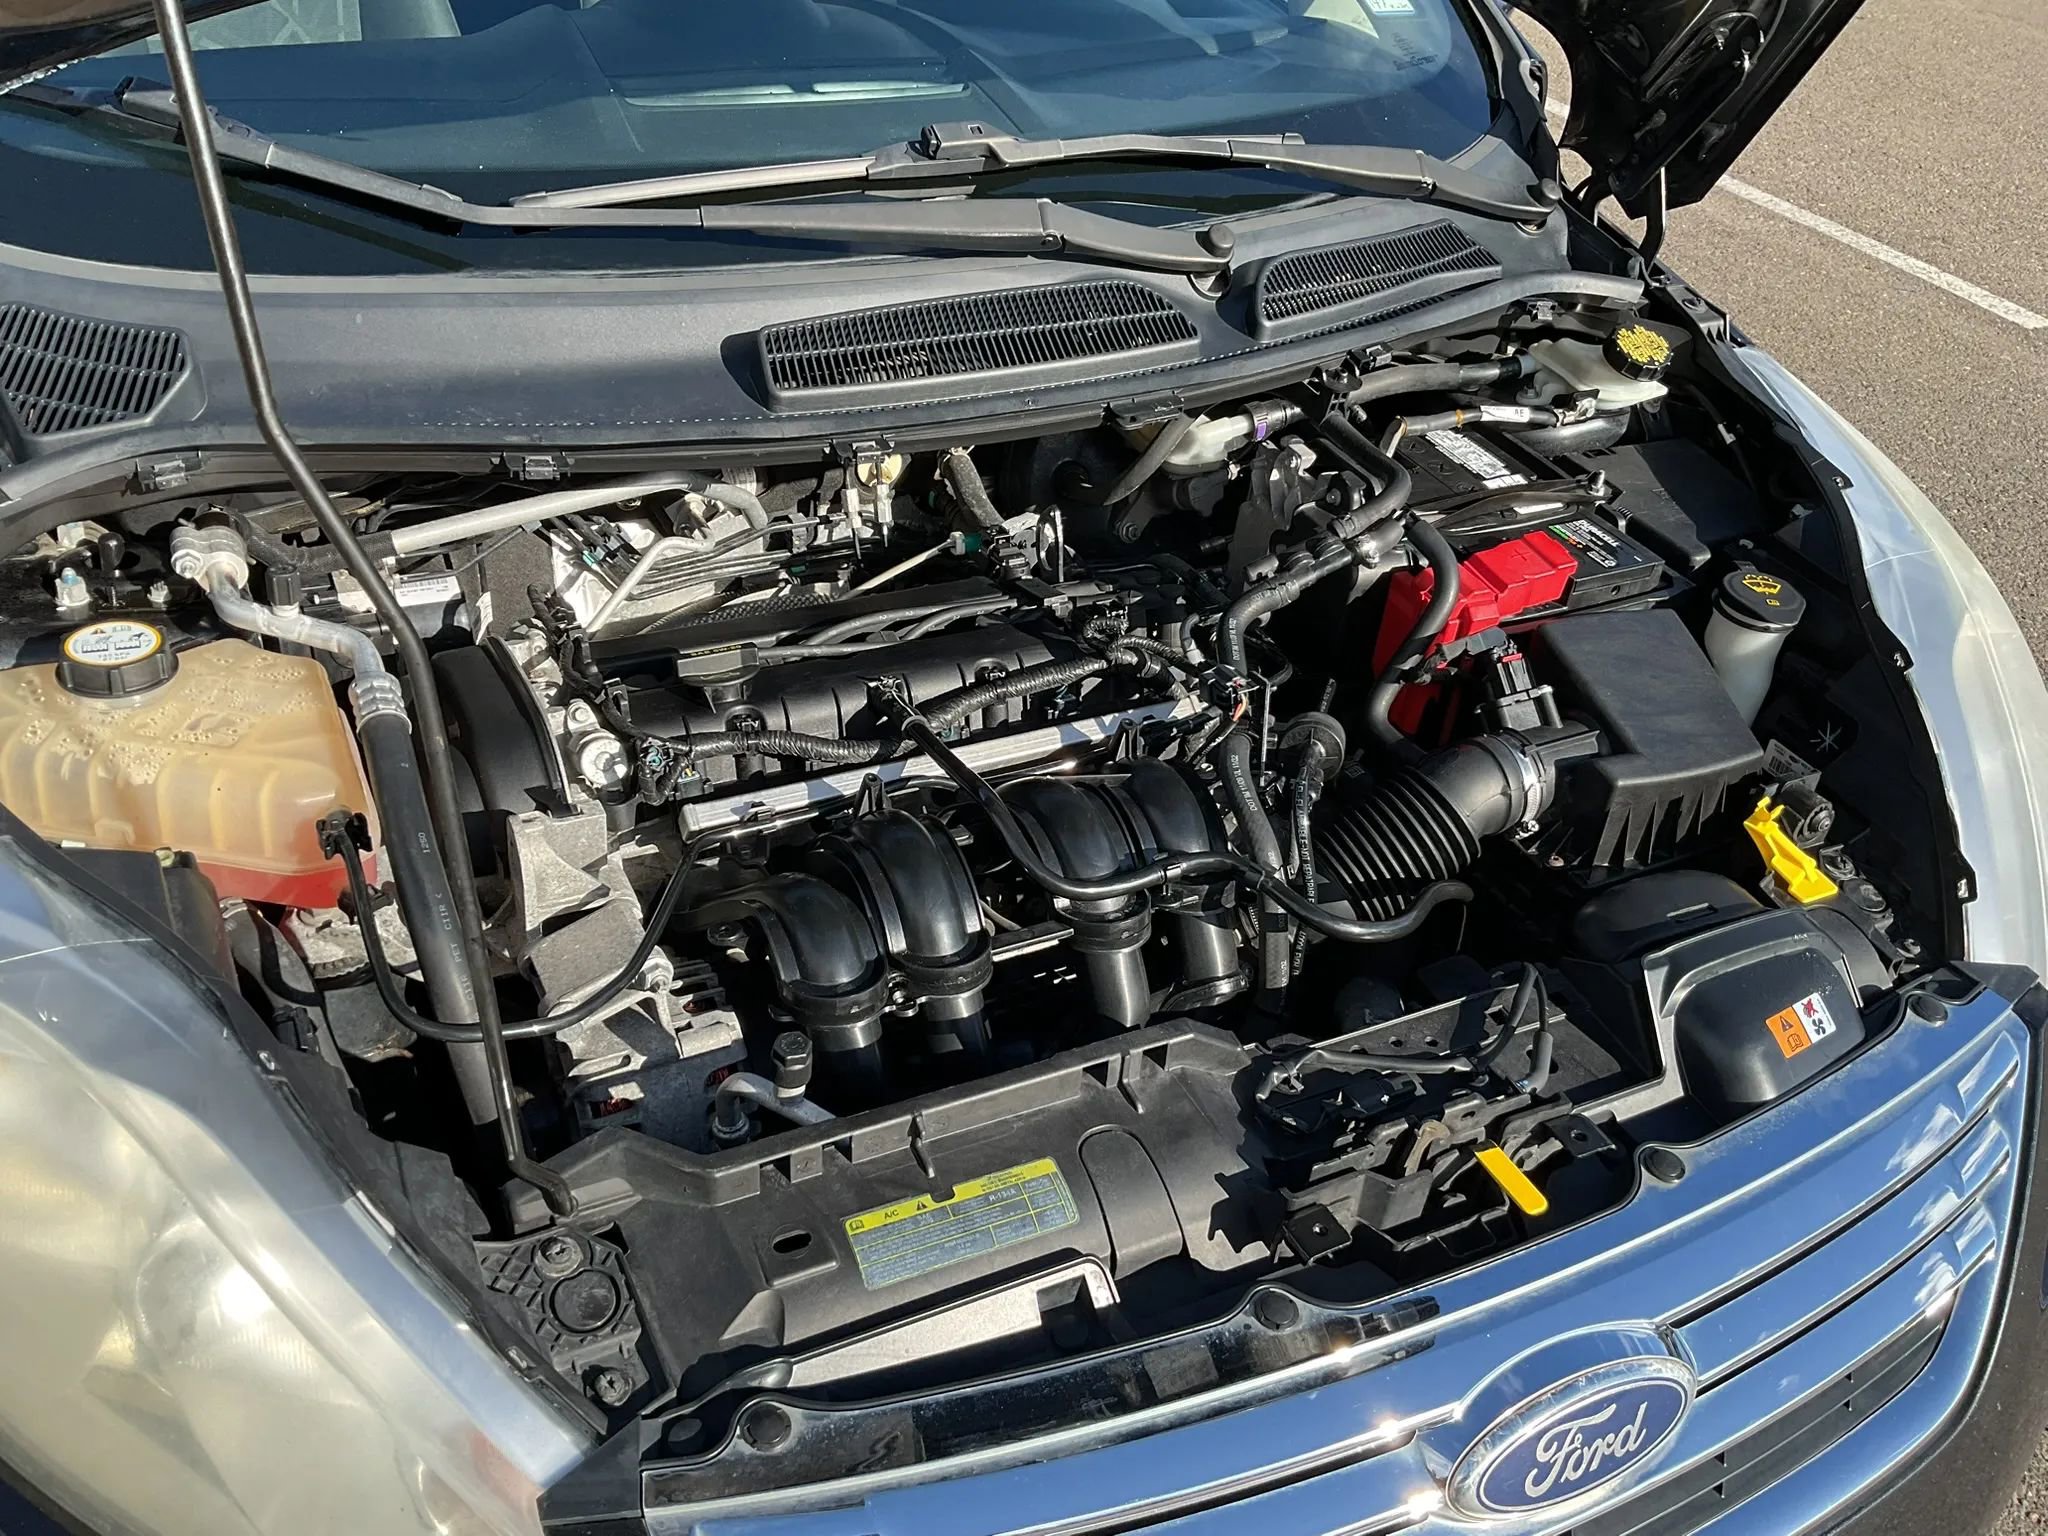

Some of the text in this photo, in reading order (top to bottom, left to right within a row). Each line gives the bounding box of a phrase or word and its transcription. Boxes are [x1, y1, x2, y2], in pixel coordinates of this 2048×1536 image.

[1578, 520, 1621, 547] DURACELL
[884, 1209, 900, 1219] A/C
[1524, 1401, 1648, 1498] Ford
